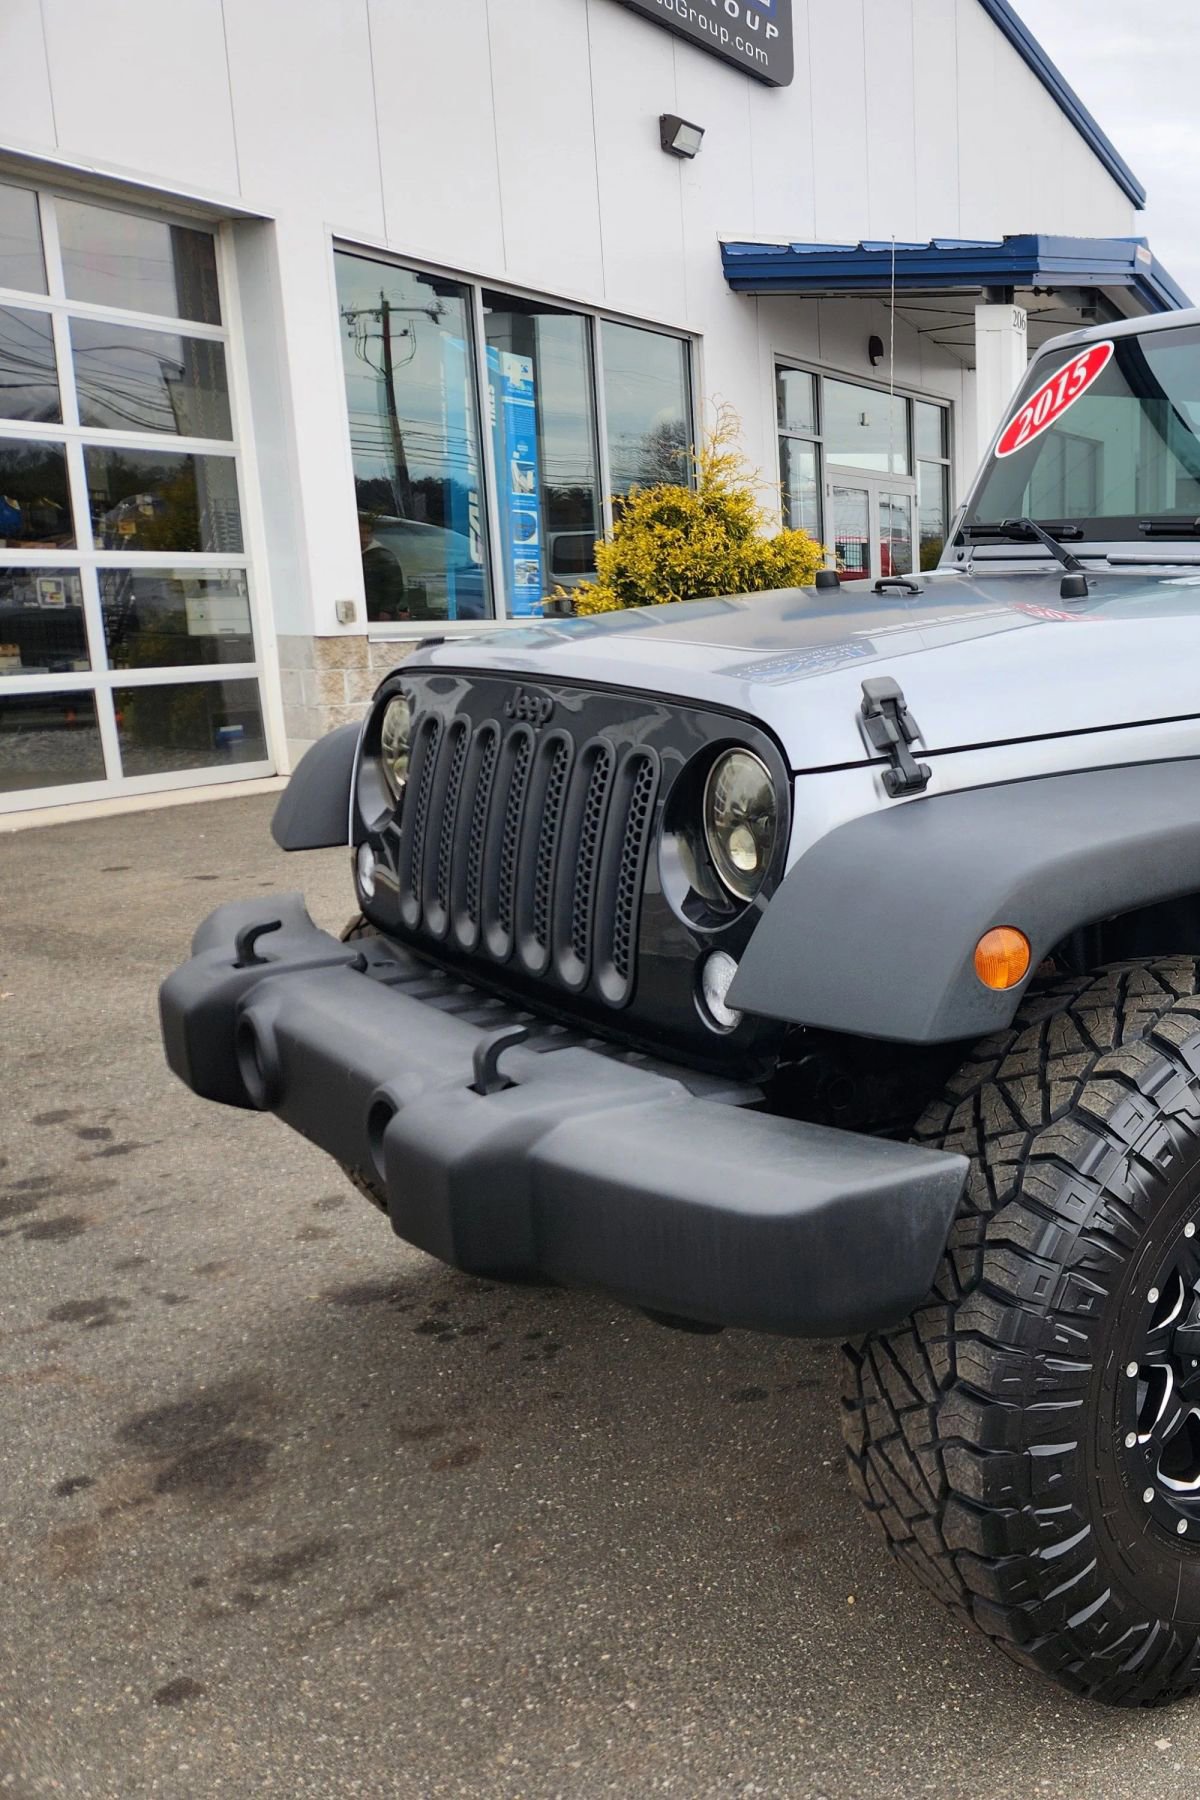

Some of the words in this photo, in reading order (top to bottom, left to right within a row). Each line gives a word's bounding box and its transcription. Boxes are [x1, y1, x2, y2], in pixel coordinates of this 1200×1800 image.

[1012, 310, 1026, 331] 206
[1013, 352, 1091, 448] 2015
[503, 686, 553, 729] Jeep
